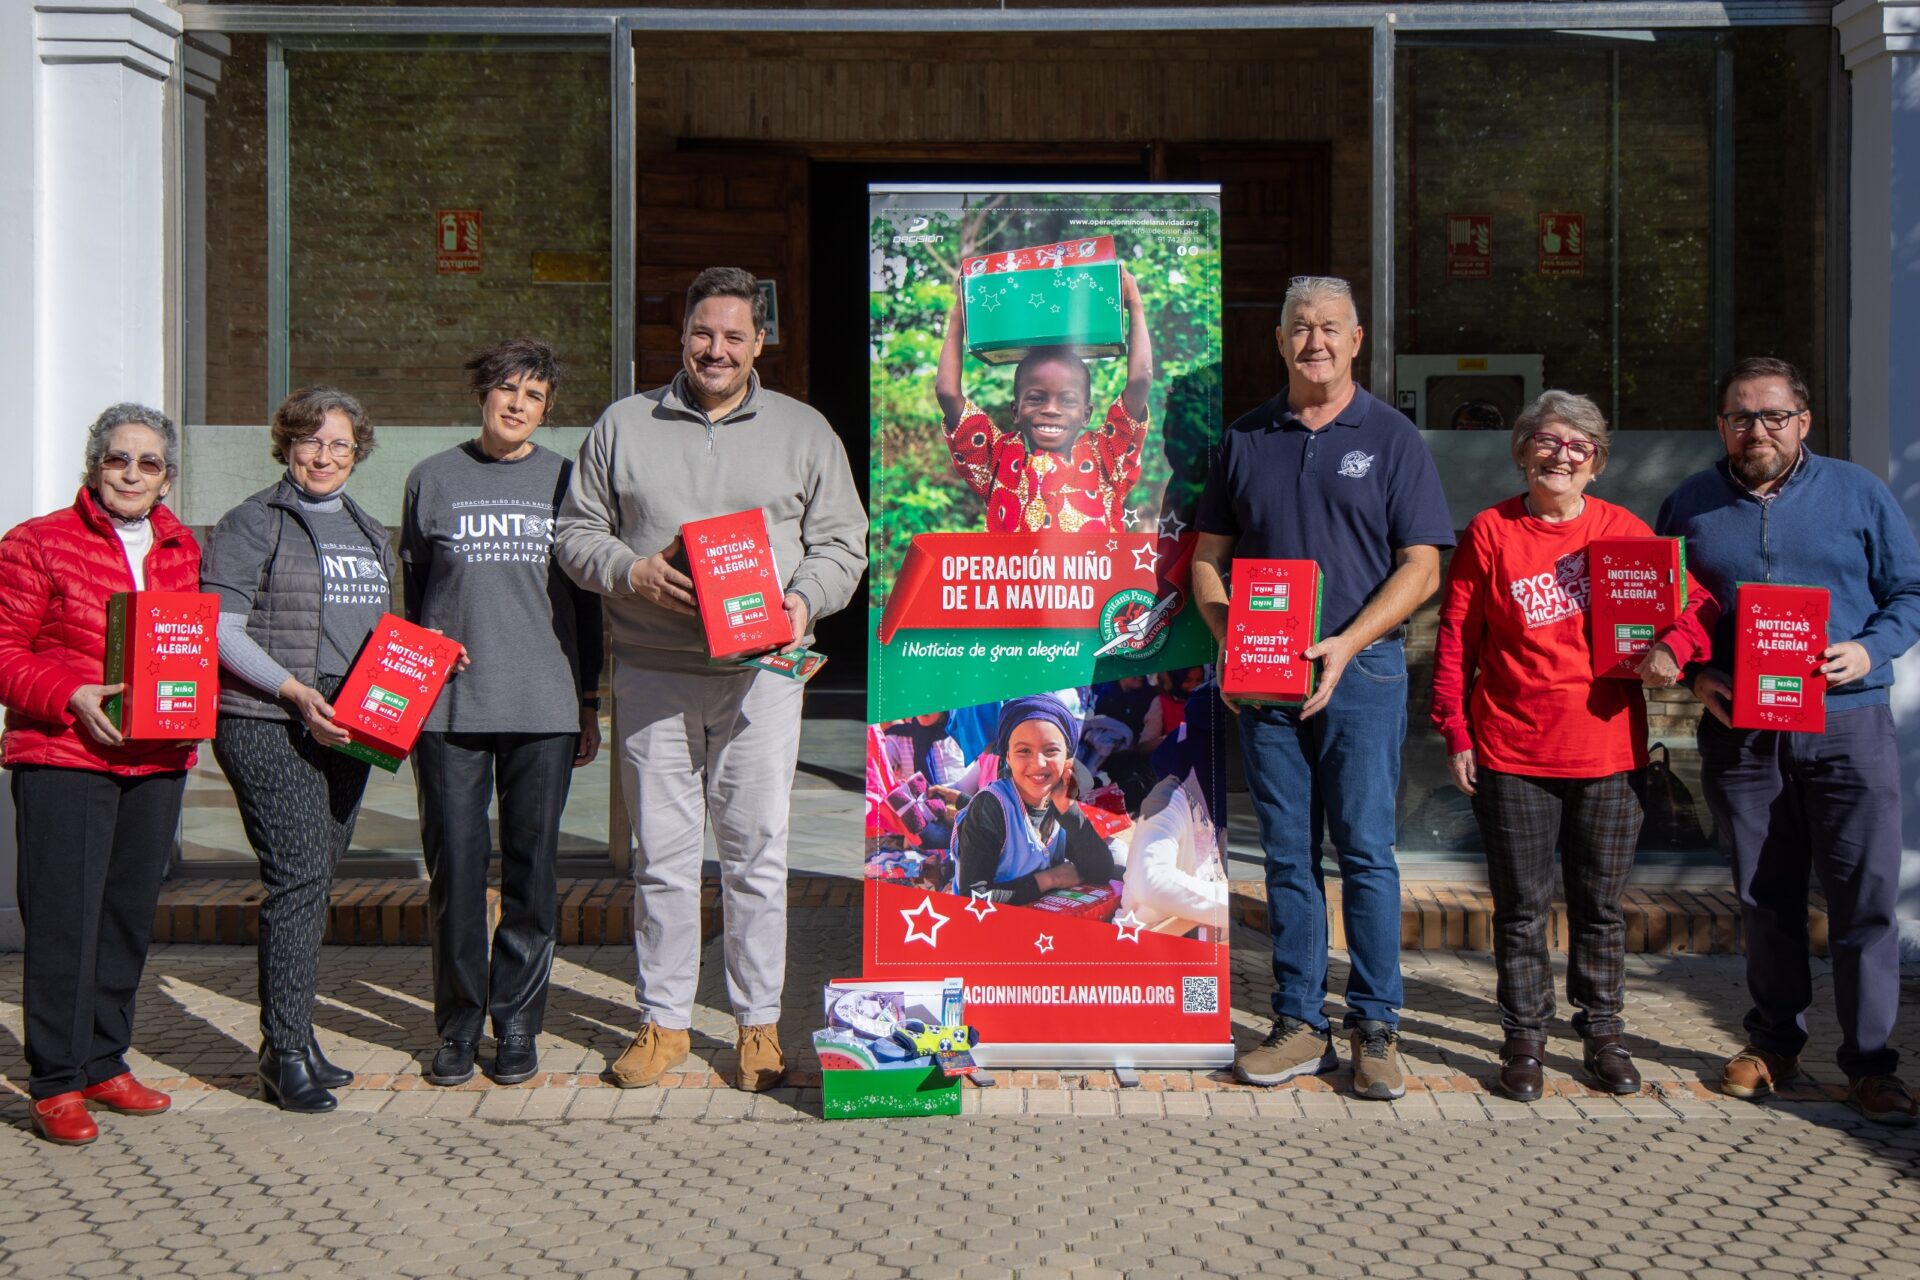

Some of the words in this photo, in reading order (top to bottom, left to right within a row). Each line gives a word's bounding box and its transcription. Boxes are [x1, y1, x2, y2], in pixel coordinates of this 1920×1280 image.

[1069, 218, 1199, 227] www.operacionninodelanavidad.org
[452, 514, 555, 542] JUNTOS
[454, 542, 550, 553] COMPARTIEND
[706, 540, 755, 558] ¡NOTICIAS
[468, 553, 546, 563] ESPERANZA
[322, 555, 388, 582] NTOS
[713, 558, 758, 576] ALEGRÍA!
[942, 549, 1056, 581] OPERACIÓN
[1063, 551, 1112, 580] NIÑO
[1608, 569, 1657, 580] ¡NOTICIAS
[327, 583, 390, 595] PARTIEND
[1254, 585, 1273, 593] NIÑA
[1511, 572, 1554, 598] #YO
[324, 594, 382, 604] SPERANZA
[942, 586, 968, 610] DE
[975, 586, 1000, 610] LA
[1006, 586, 1095, 610] NAVIDAD
[1610, 587, 1657, 599] ALEGRÍA!
[741, 597, 760, 606] NIÑO
[1253, 600, 1272, 608] NIÑO
[745, 611, 764, 620] NIÑA
[1104, 593, 1131, 641] Samaritan's
[1131, 591, 1155, 607] Purse
[155, 623, 203, 634] ¡NOTICIAS
[1756, 619, 1810, 631] ¡NOTICIAS
[1131, 620, 1166, 648] OPERATION
[1632, 628, 1651, 636] NIÑO
[1243, 635, 1289, 646] ALEGRÍA!
[1757, 639, 1808, 651] ALEGRÍA!
[156, 643, 201, 654] ALEGRÍA!
[387, 641, 435, 668] ¡NOTICIAS
[902, 642, 964, 658] ¡Noticias
[968, 642, 985, 657] de
[990, 646, 1023, 663] gran
[1028, 641, 1080, 663] alegría!
[1241, 653, 1290, 664] ¡NOTICIAS
[381, 657, 427, 682] ALEGRÍA!
[174, 685, 194, 693] NIÑO
[1778, 680, 1798, 688] NIÑO
[173, 700, 192, 708] NIÑA
[384, 694, 404, 707] NIÑO
[1777, 695, 1798, 703] NIÑA
[378, 706, 398, 718] NIÑA
[963, 984, 1175, 1005] ACIONNINODELANAVIDAD.ORG
